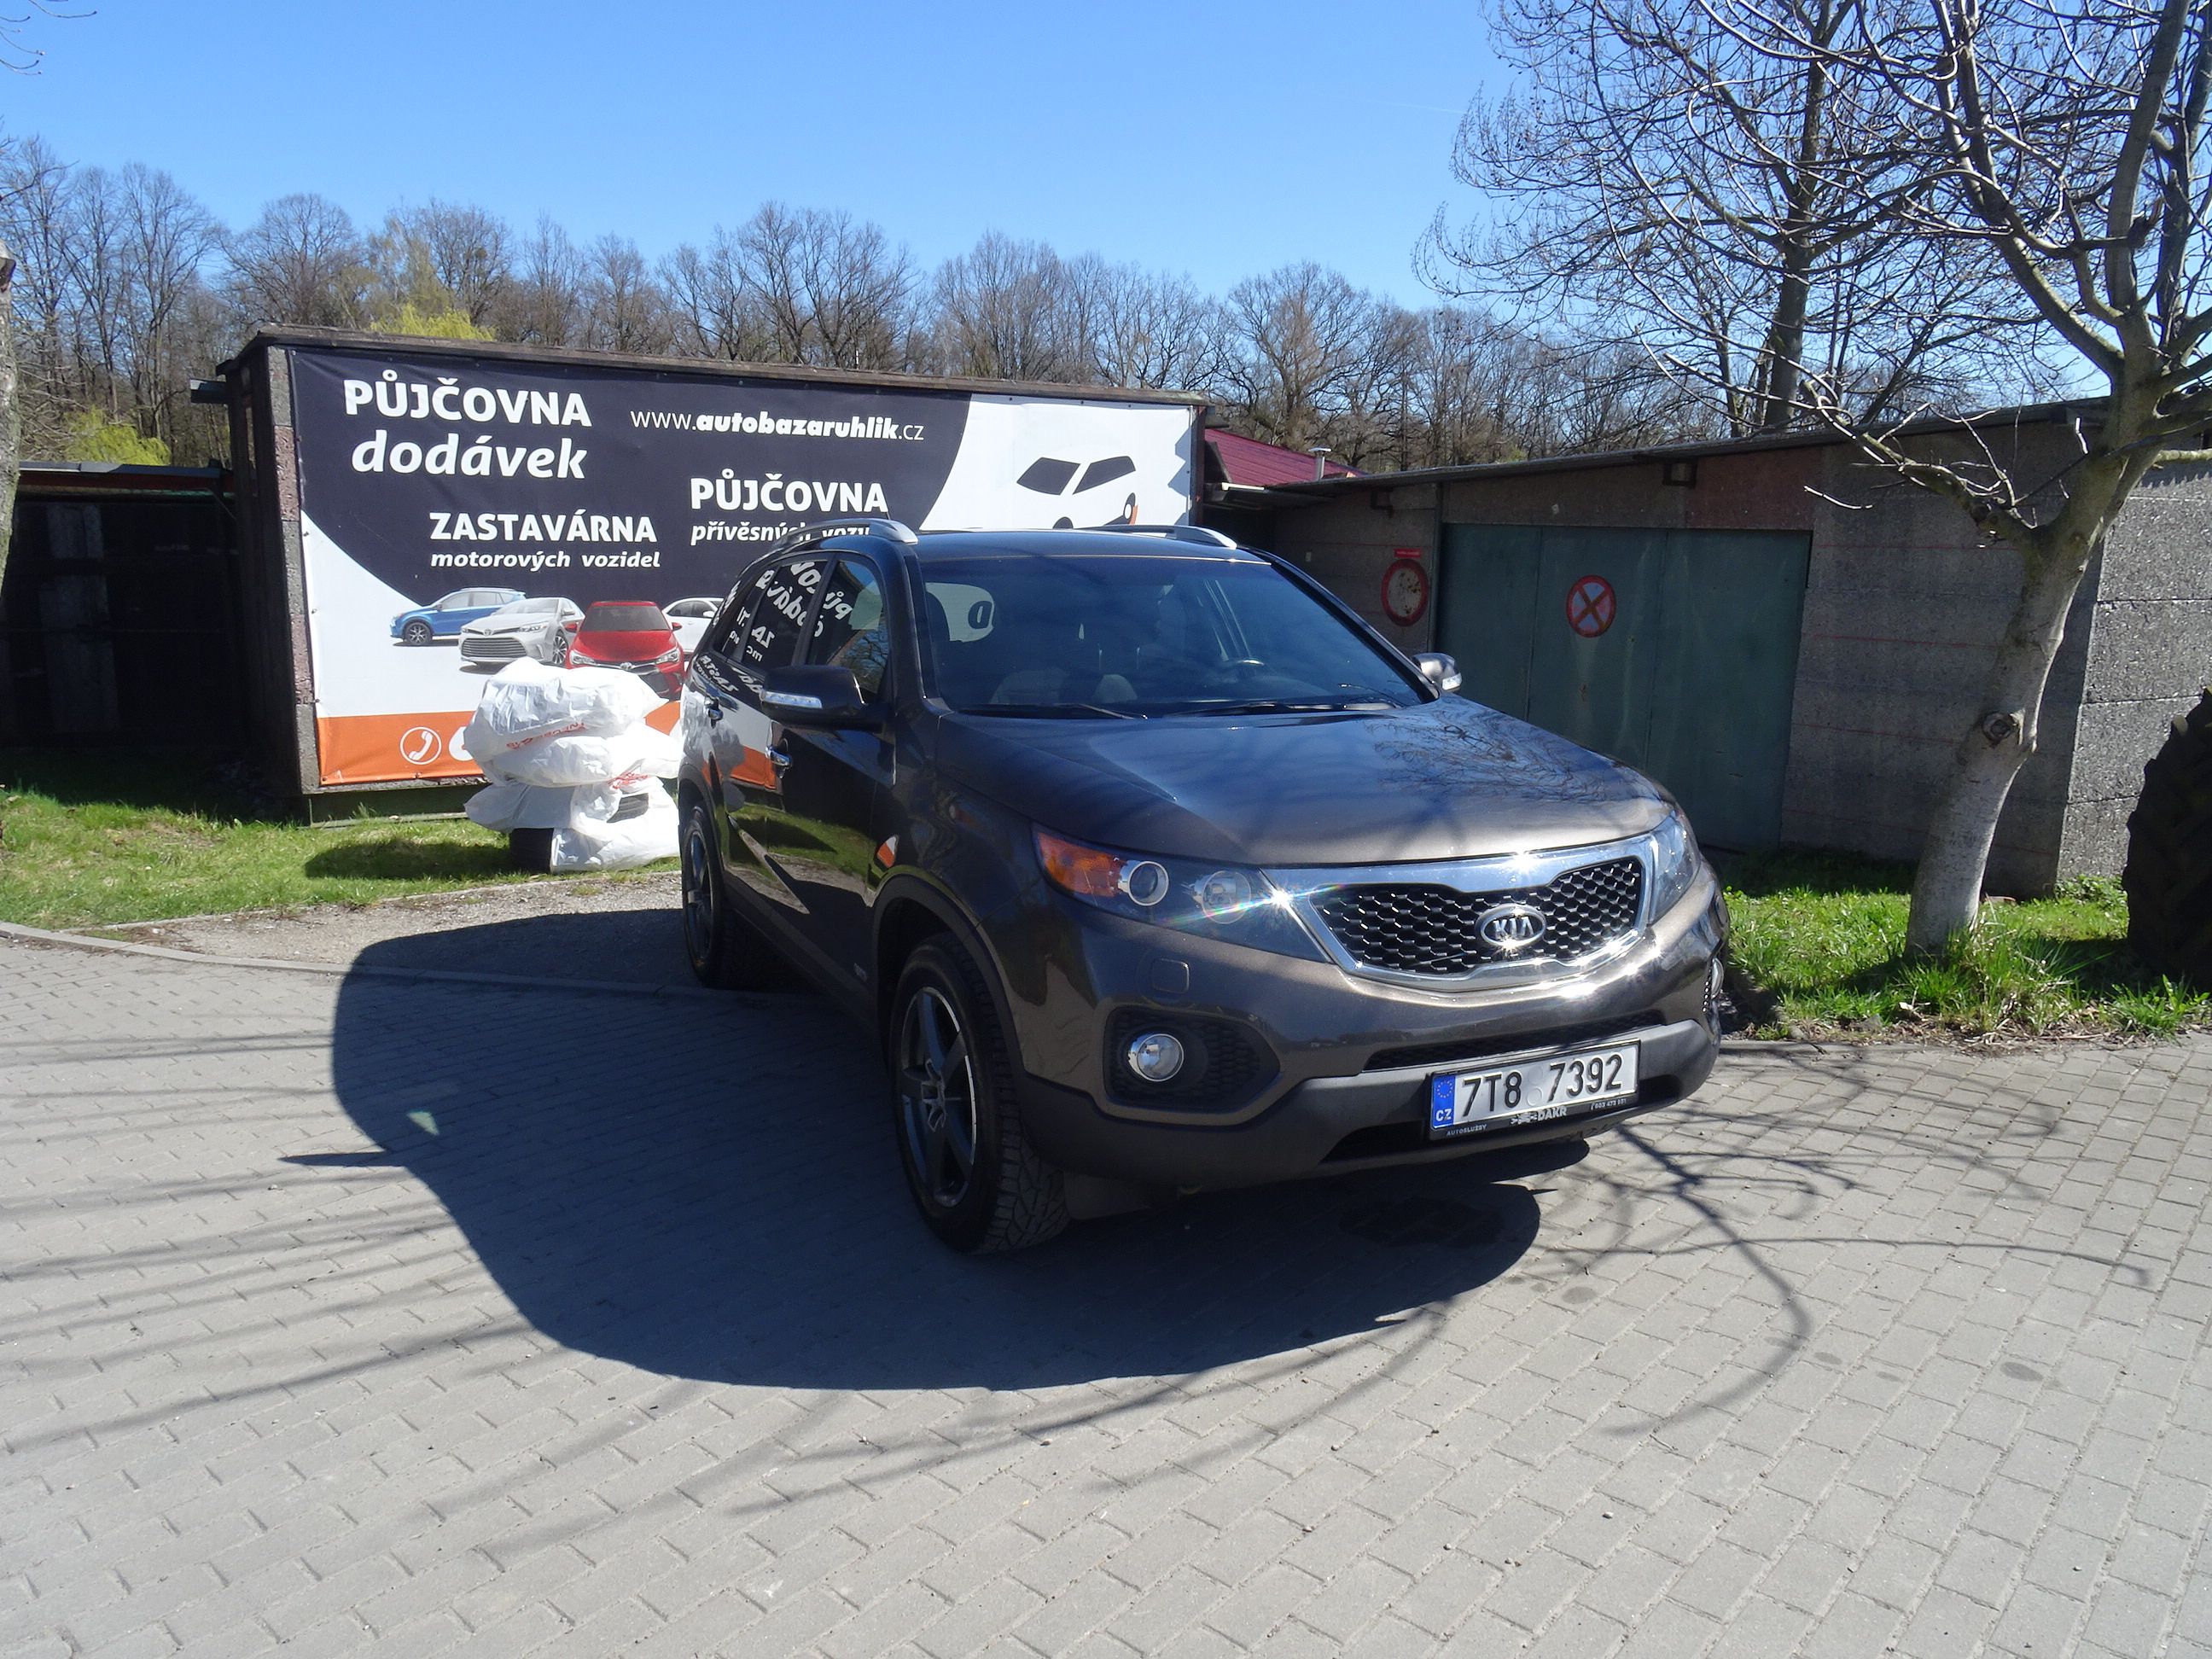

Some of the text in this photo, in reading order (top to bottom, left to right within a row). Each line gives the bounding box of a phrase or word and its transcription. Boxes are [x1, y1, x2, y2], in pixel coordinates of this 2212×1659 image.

[343, 370, 593, 427] PŮJČOVNA
[630, 410, 925, 441] www.autobazaruhlik.cz
[351, 429, 588, 480] dodávek
[690, 468, 889, 513] PŮJČOVNA
[429, 509, 658, 544] ZASTAVÁRNA
[430, 550, 661, 573] motorových vozidel
[1493, 916, 1534, 940] KIA
[1462, 1053, 1623, 1118] 7T8 7392
[1435, 1109, 1452, 1122] CZ
